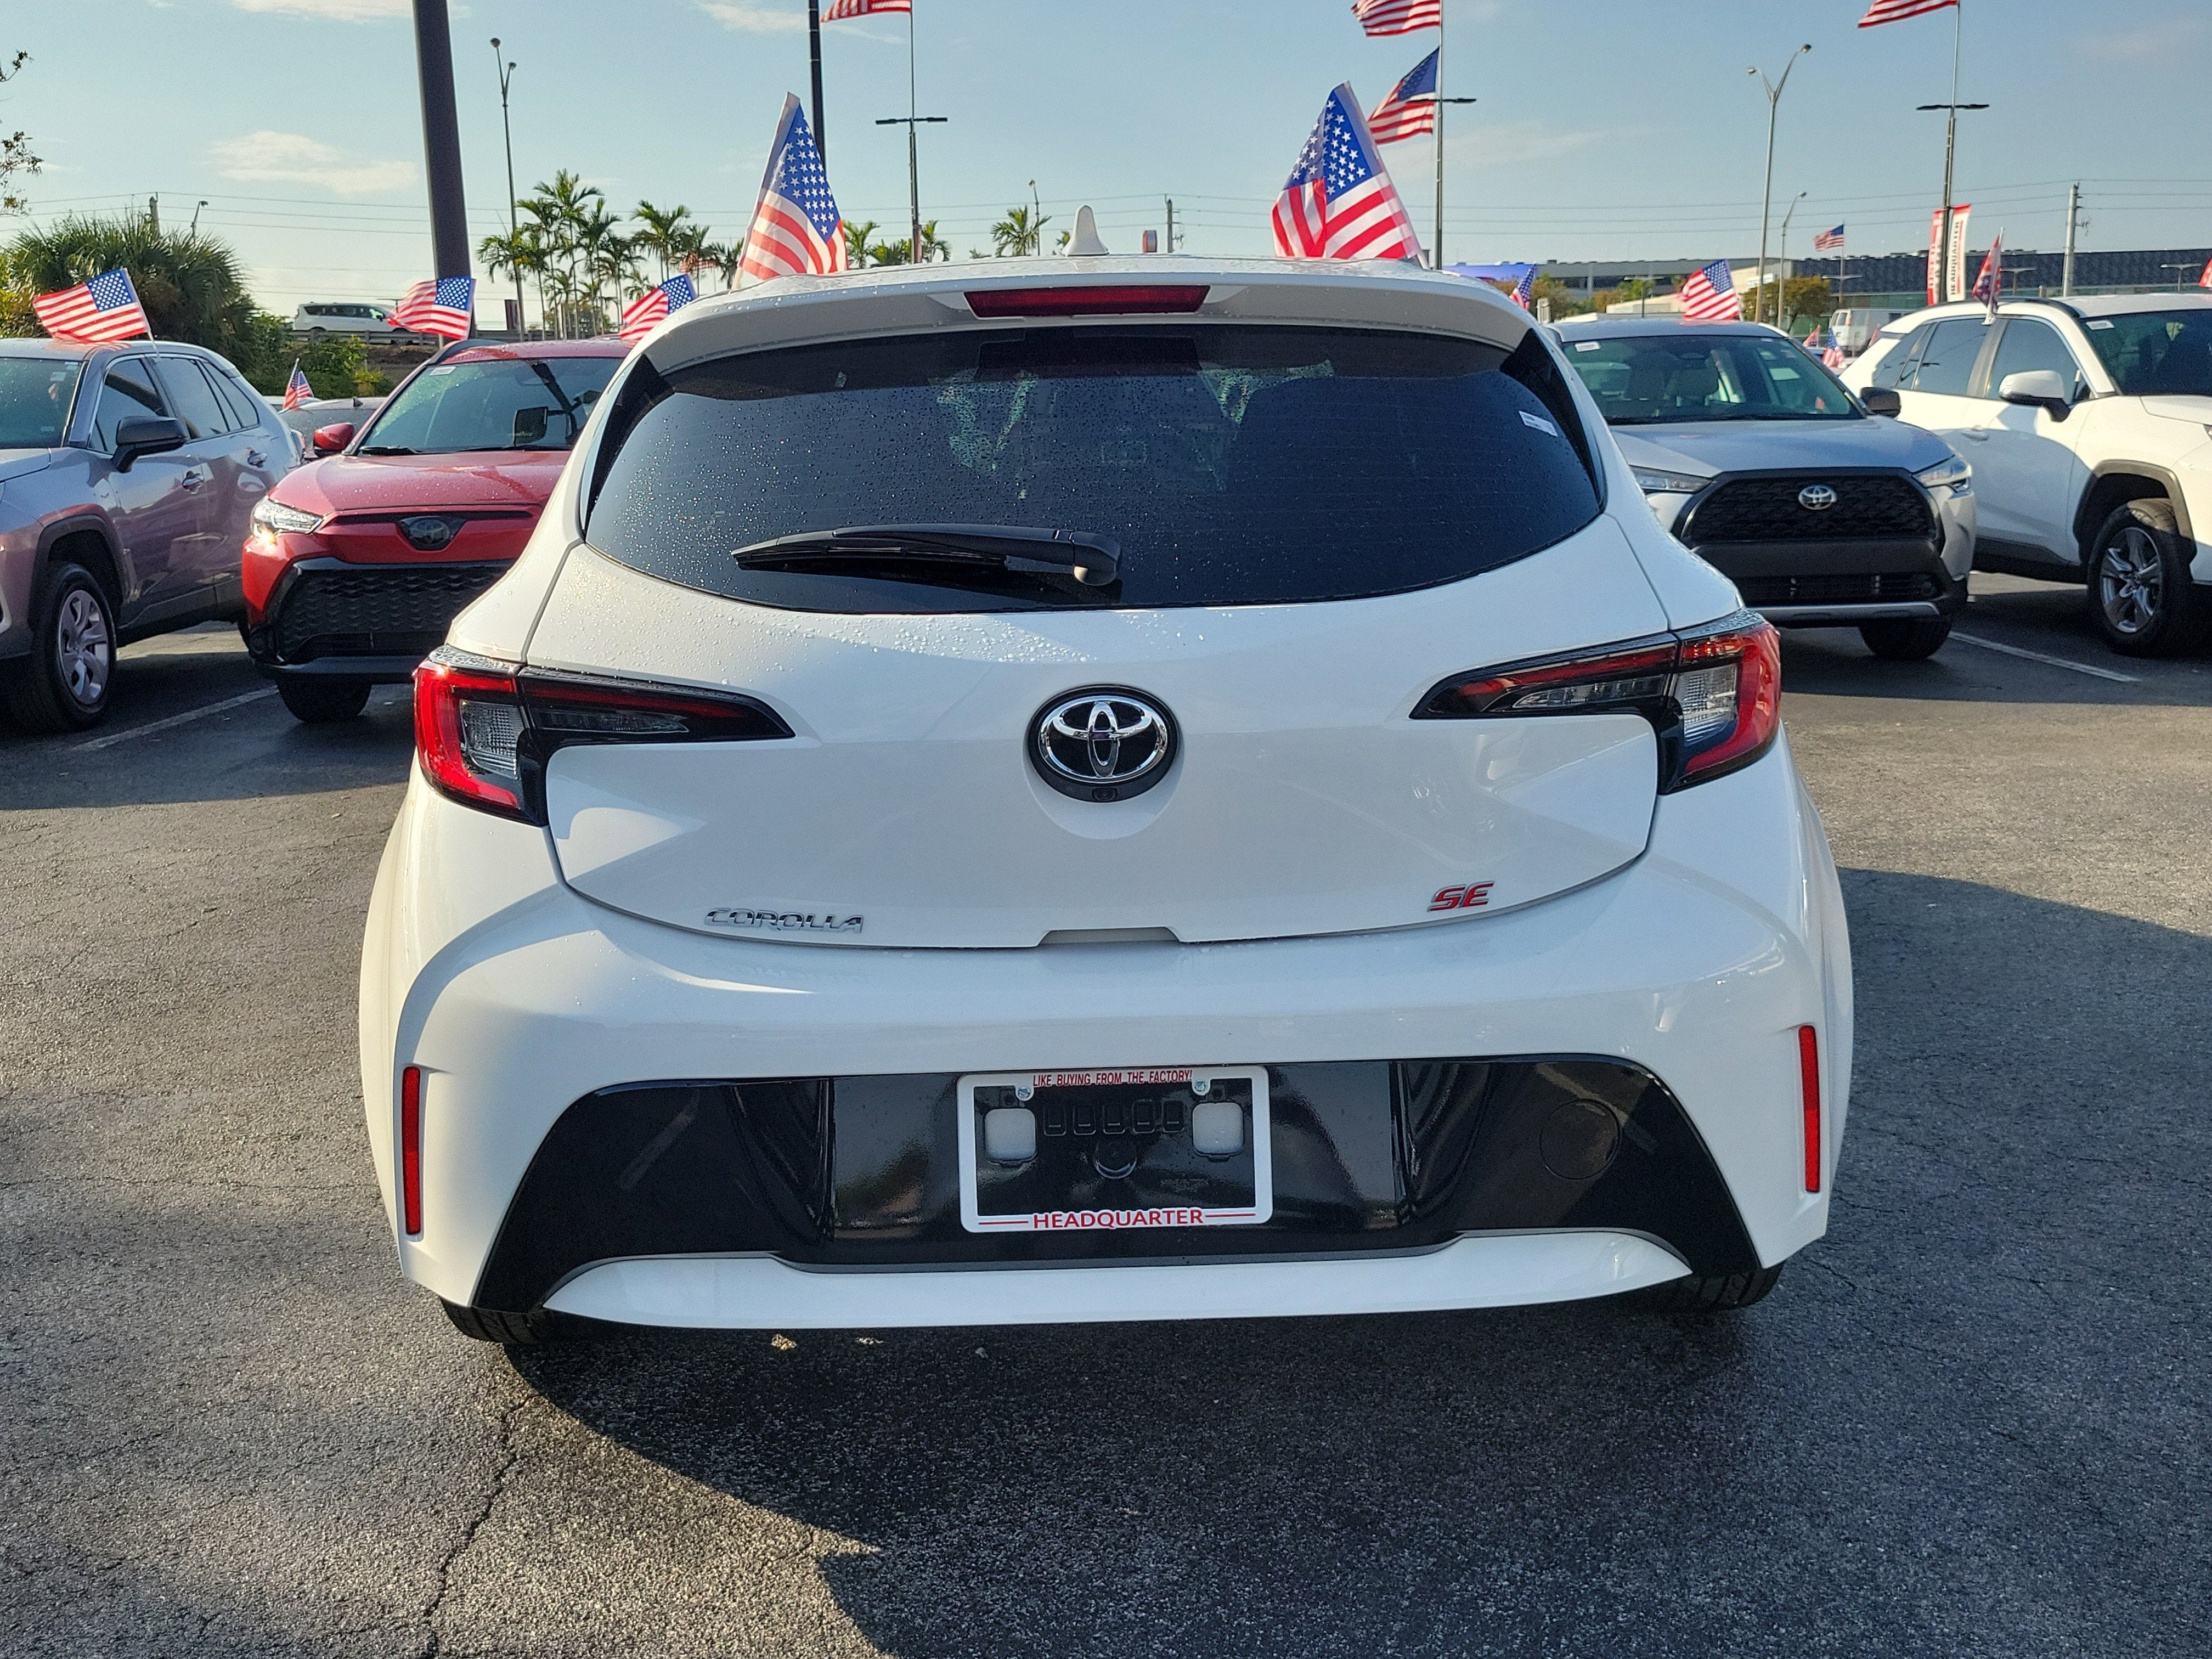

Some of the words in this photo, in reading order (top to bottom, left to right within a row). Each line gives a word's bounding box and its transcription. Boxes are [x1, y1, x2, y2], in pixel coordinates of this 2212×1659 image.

[1427, 881, 1495, 912] SE
[704, 907, 864, 933] COROLLA
[1033, 1074, 1052, 1086] LIKE
[1057, 1073, 1091, 1086] BUYING
[1097, 1072, 1122, 1085] FROM
[1127, 1071, 1144, 1084] THE
[1149, 1070, 1192, 1083] FACTORY!
[1033, 1209, 1204, 1229] HEADQUARTER
